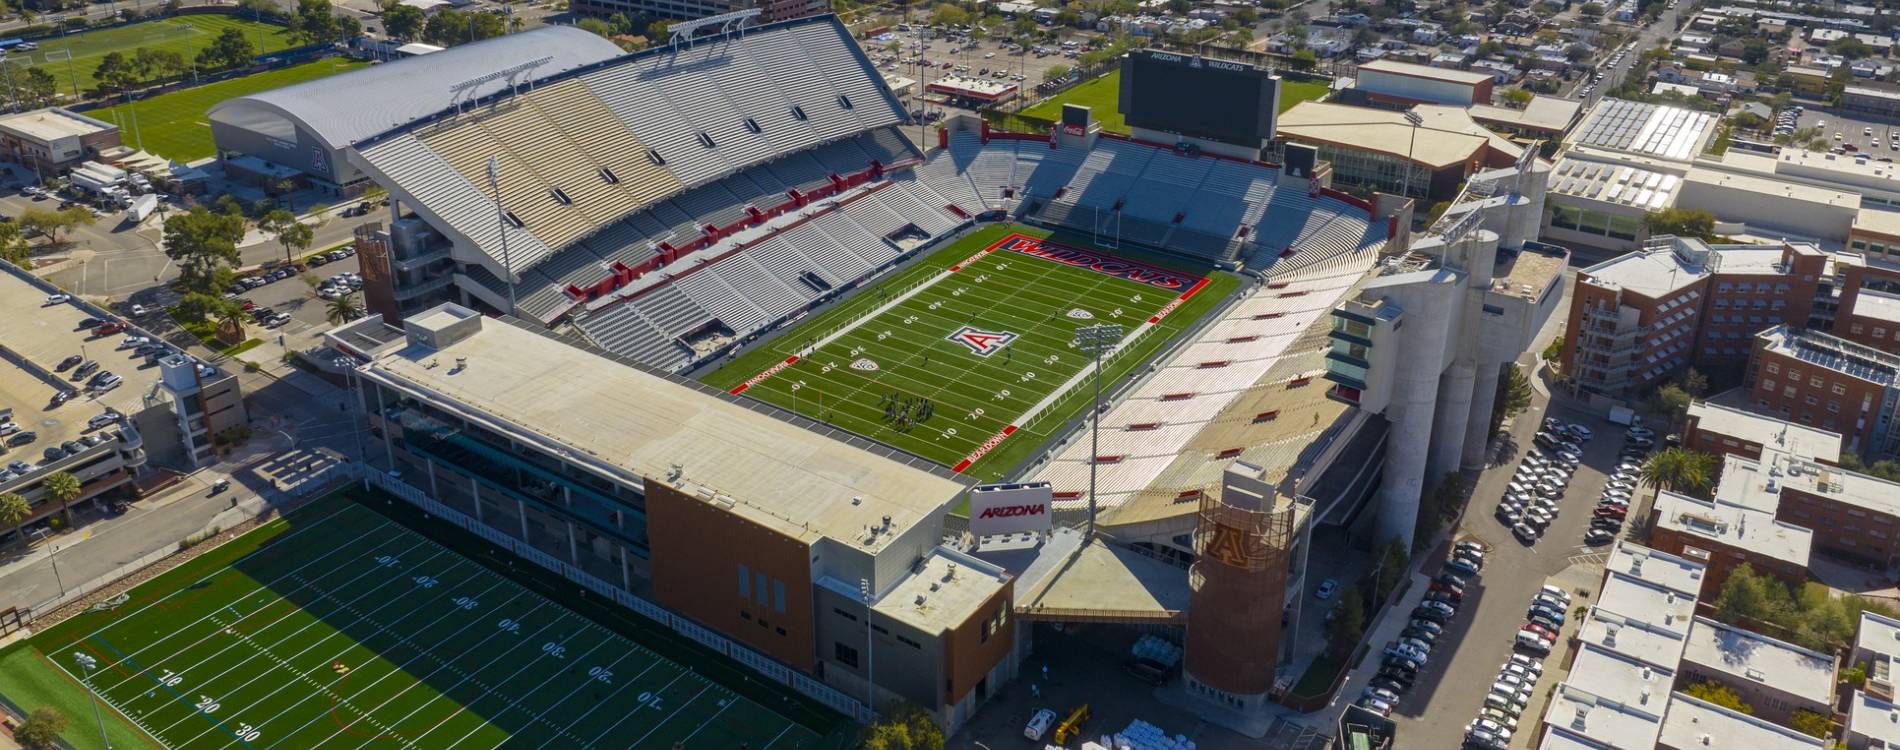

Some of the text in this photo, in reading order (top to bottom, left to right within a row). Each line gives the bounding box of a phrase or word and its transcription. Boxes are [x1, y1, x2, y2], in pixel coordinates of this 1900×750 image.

[1151, 53, 1182, 62] ARIZONA
[1209, 61, 1244, 71] WILDCATS
[1008, 239, 1191, 289] WILDCATS
[904, 315, 919, 325] 50
[944, 325, 1020, 358] A
[1044, 355, 1059, 365] 50
[1021, 371, 1036, 382] 40
[791, 380, 806, 391] 10
[994, 389, 1011, 401] 30
[968, 407, 985, 420] 20
[942, 427, 957, 439] 10
[979, 504, 1045, 519] ARIZONA
[378, 555, 400, 567] 10
[416, 576, 439, 588] 20
[456, 597, 479, 610] 30
[498, 618, 520, 632] 40
[542, 642, 566, 657] 30
[158, 670, 183, 687] 10
[588, 666, 613, 682] 20
[195, 697, 221, 713] 20
[637, 692, 663, 708] 10
[235, 724, 261, 742] 30
